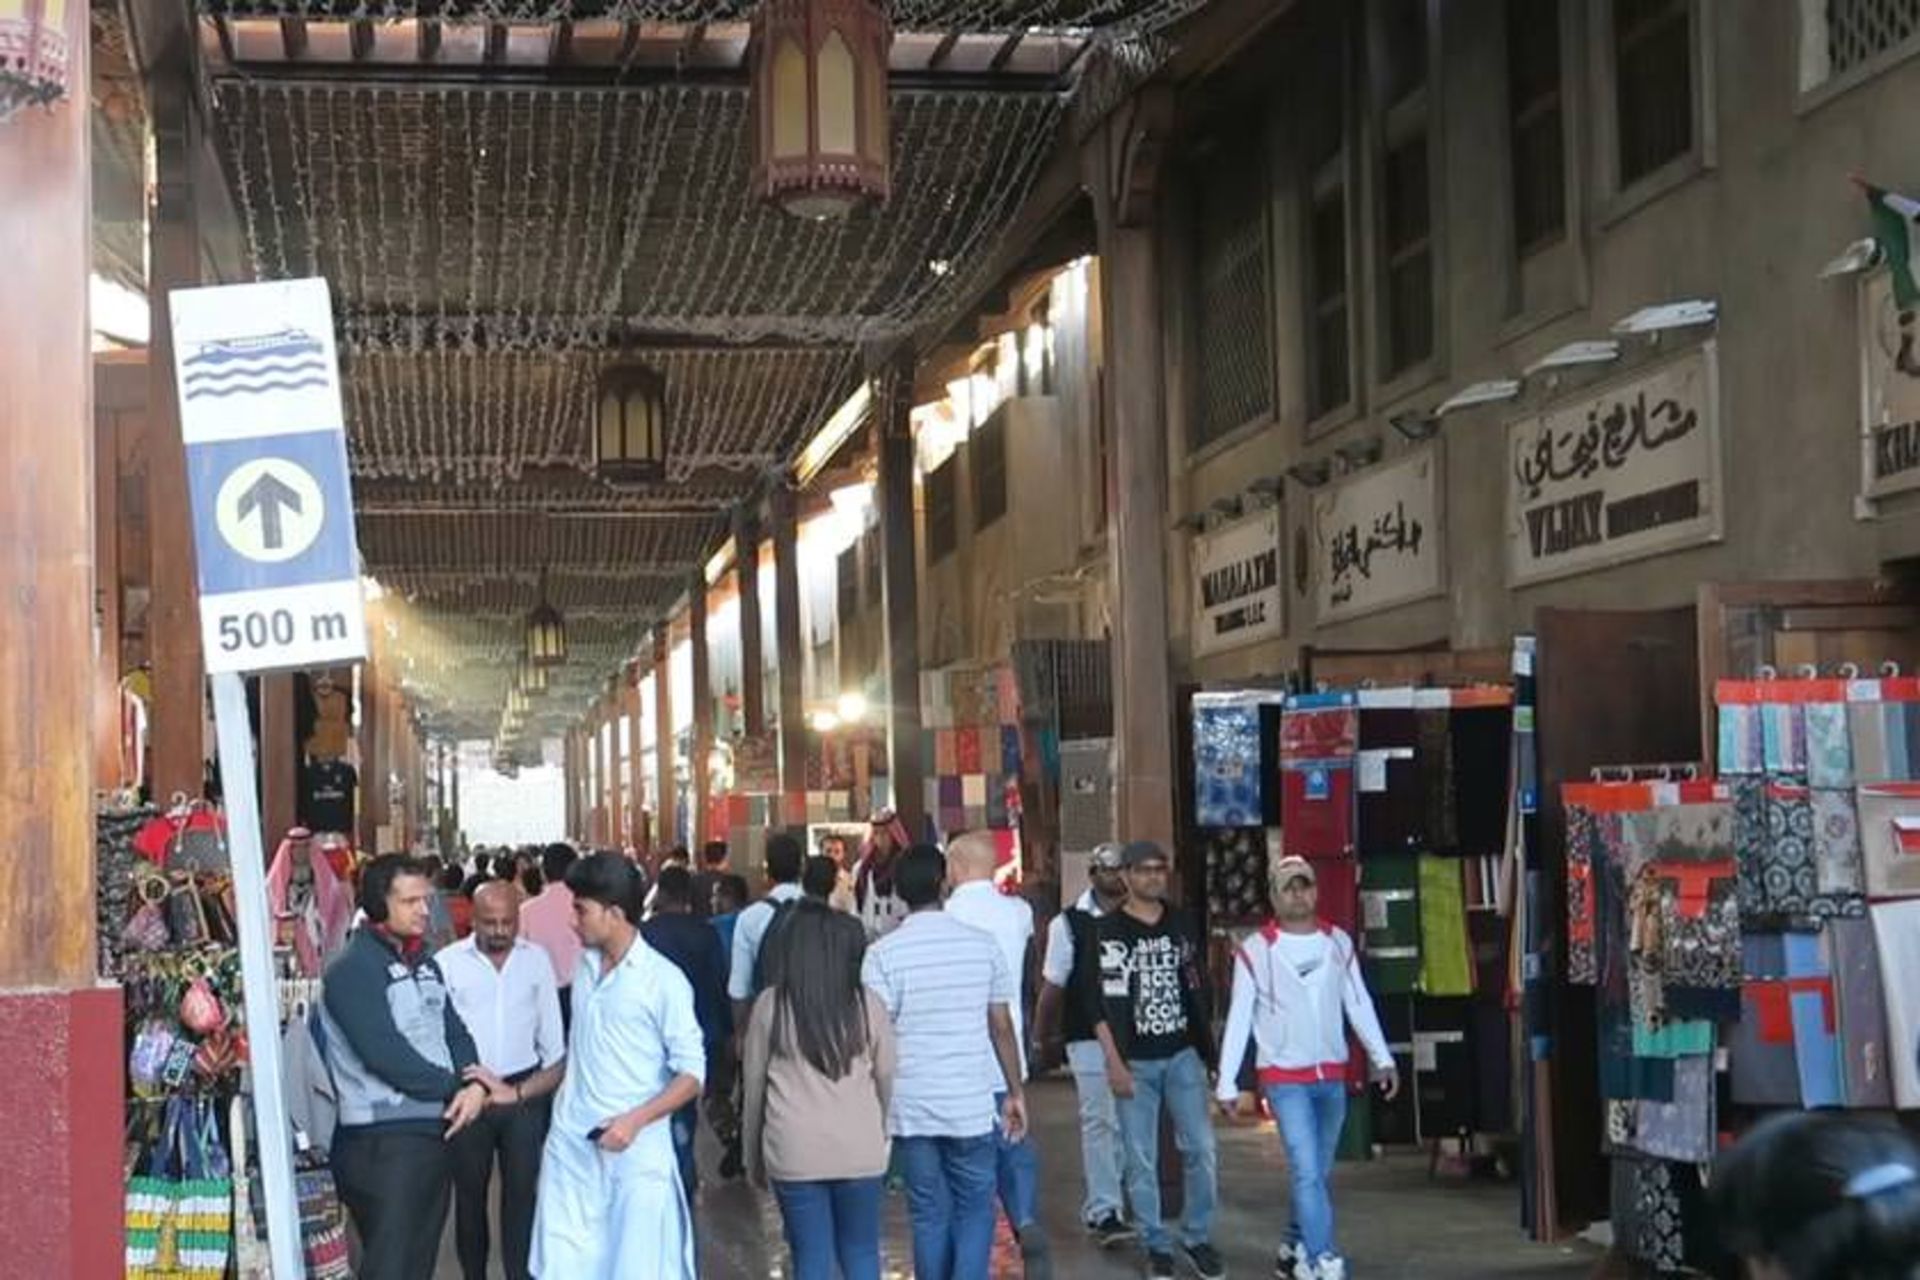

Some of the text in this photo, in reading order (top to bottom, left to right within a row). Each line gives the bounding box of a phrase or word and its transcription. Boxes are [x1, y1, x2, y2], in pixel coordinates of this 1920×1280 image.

[1523, 489, 1604, 558] VIJAY
[219, 608, 348, 652] 500 m
